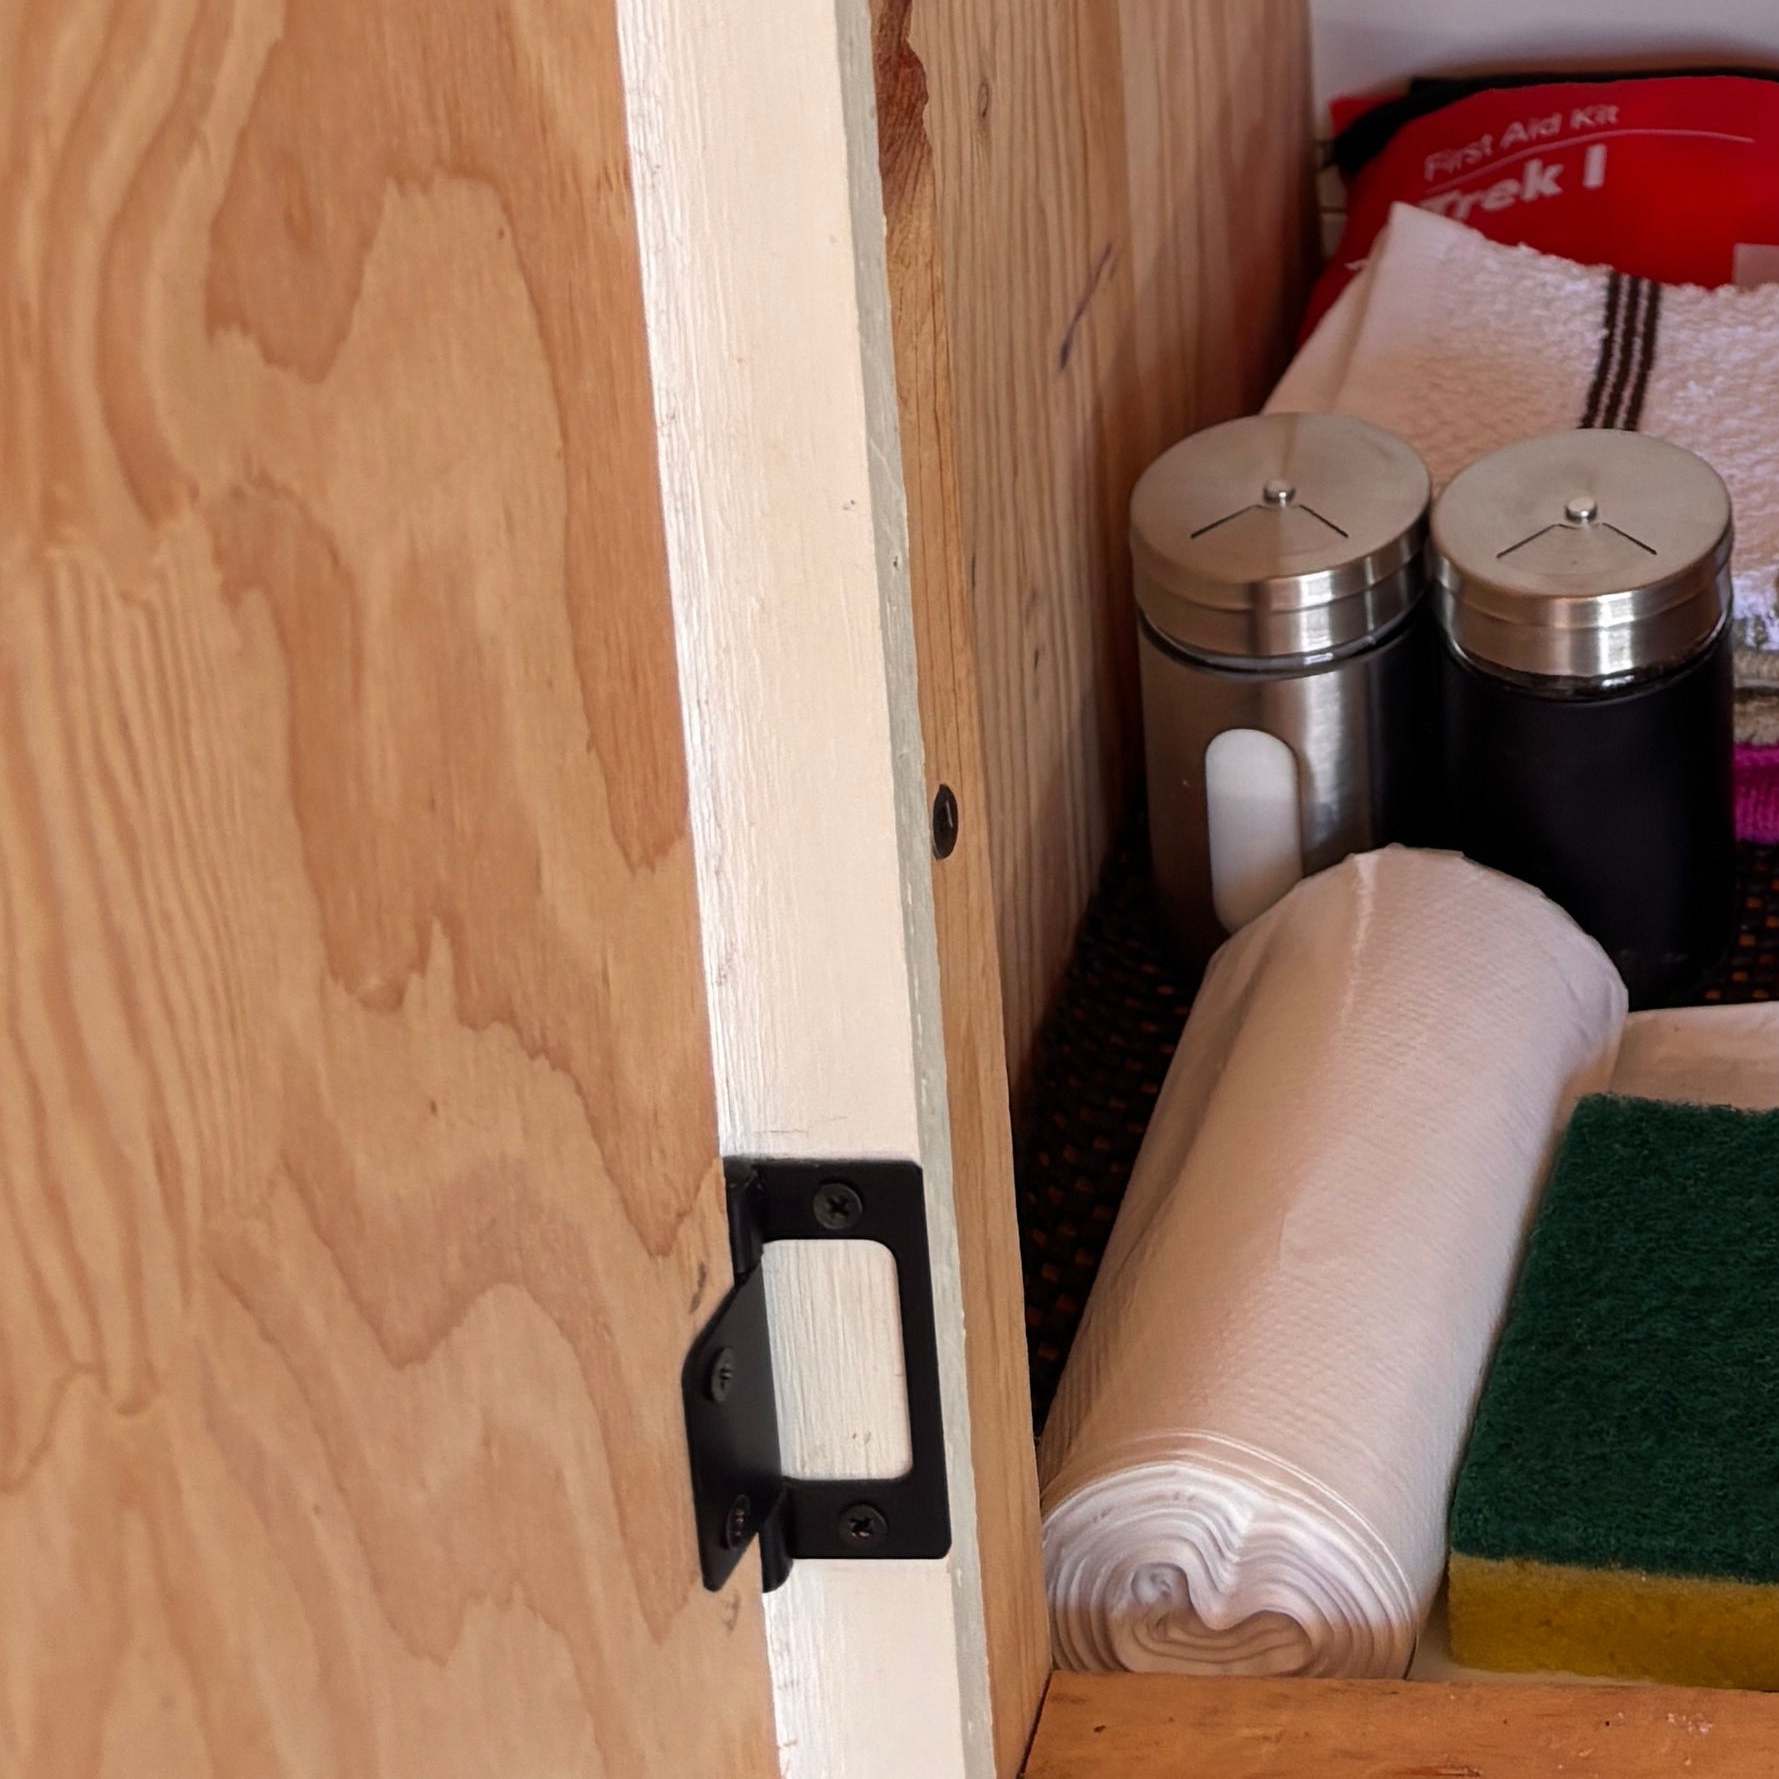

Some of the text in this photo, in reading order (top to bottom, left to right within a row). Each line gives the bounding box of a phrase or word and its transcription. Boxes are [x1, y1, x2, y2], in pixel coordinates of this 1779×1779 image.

[1423, 103, 1621, 183] First Aid Kit
[1417, 157, 1567, 223] Trek
